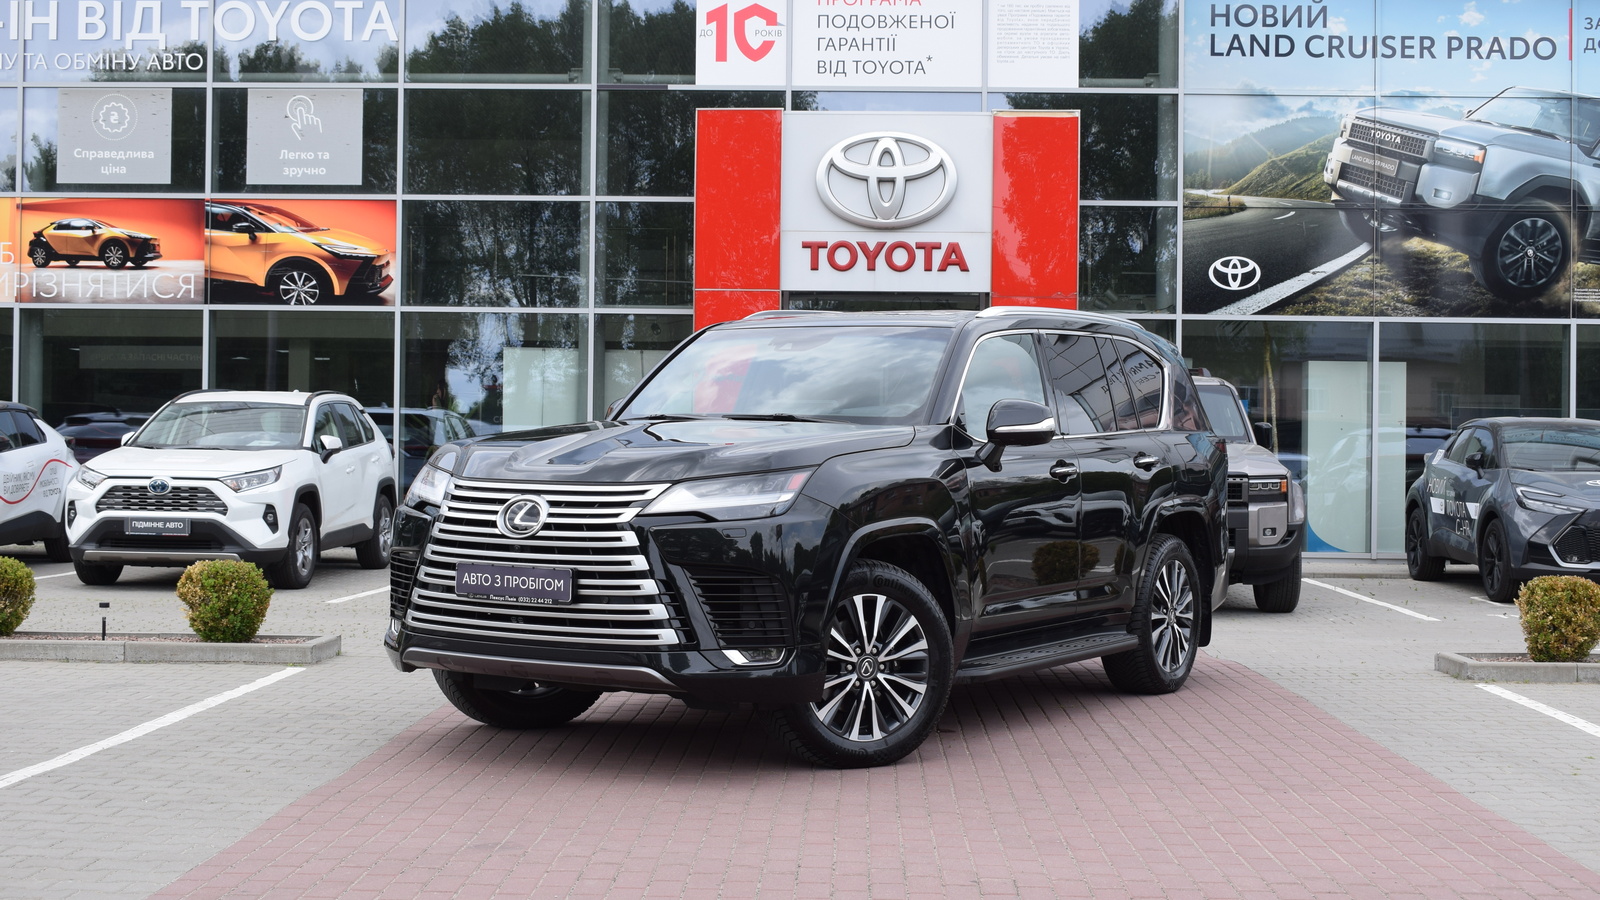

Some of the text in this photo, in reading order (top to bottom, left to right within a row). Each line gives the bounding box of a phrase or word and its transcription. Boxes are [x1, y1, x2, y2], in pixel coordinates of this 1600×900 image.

[817, 11, 957, 32] ПОДОВЖЕНОЇ
[1210, 0, 1328, 28] НОВИЙ
[78, 1, 166, 50] ВІД
[181, 1, 399, 41] TOYOTA
[699, 29, 714, 38] ДО
[754, 29, 783, 37] РОКІВ
[817, 34, 898, 51] ГАРАНТІЇ
[1210, 34, 1557, 60] LAND CRUISER PRADO
[1583, 38, 1600, 53] Д
[25, 53, 48, 70] ТА
[54, 53, 141, 71] ОБМІНУ
[147, 53, 204, 70] АВТО
[817, 60, 847, 77] ВІД
[1370, 130, 1401, 143] TOYOTA
[73, 148, 155, 160] Справедлива
[279, 149, 330, 160] Легко та
[101, 163, 127, 175] ціна
[282, 167, 327, 178] зручно
[801, 240, 970, 272] TOYOTA
[132, 520, 184, 529] ПІДМІННЕ АВТО
[462, 572, 564, 592] АВТО З ПРОБІГОМ
